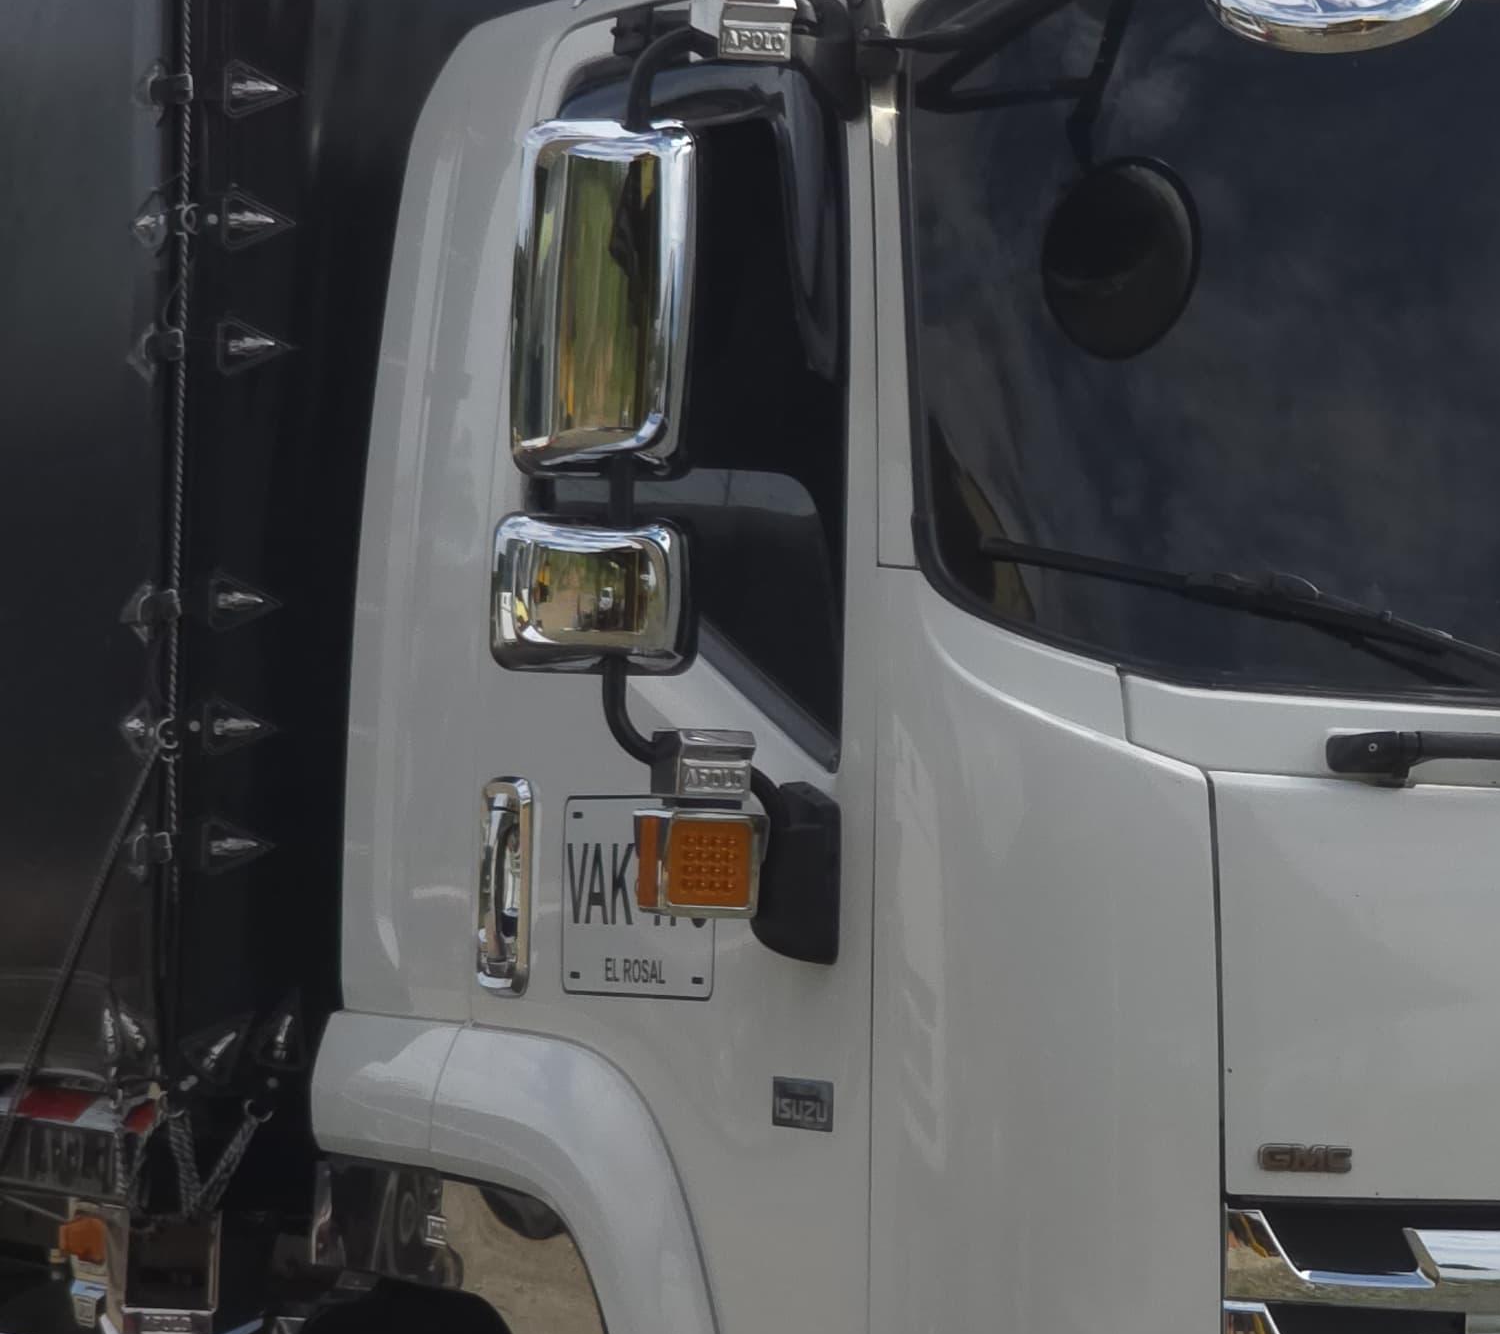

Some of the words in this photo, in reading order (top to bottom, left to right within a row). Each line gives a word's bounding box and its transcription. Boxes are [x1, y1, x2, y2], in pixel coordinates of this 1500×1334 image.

[725, 28, 786, 51] APOLO
[604, 957, 620, 983] EL
[623, 958, 666, 985] ROSAL
[775, 1097, 828, 1123] ISUZU
